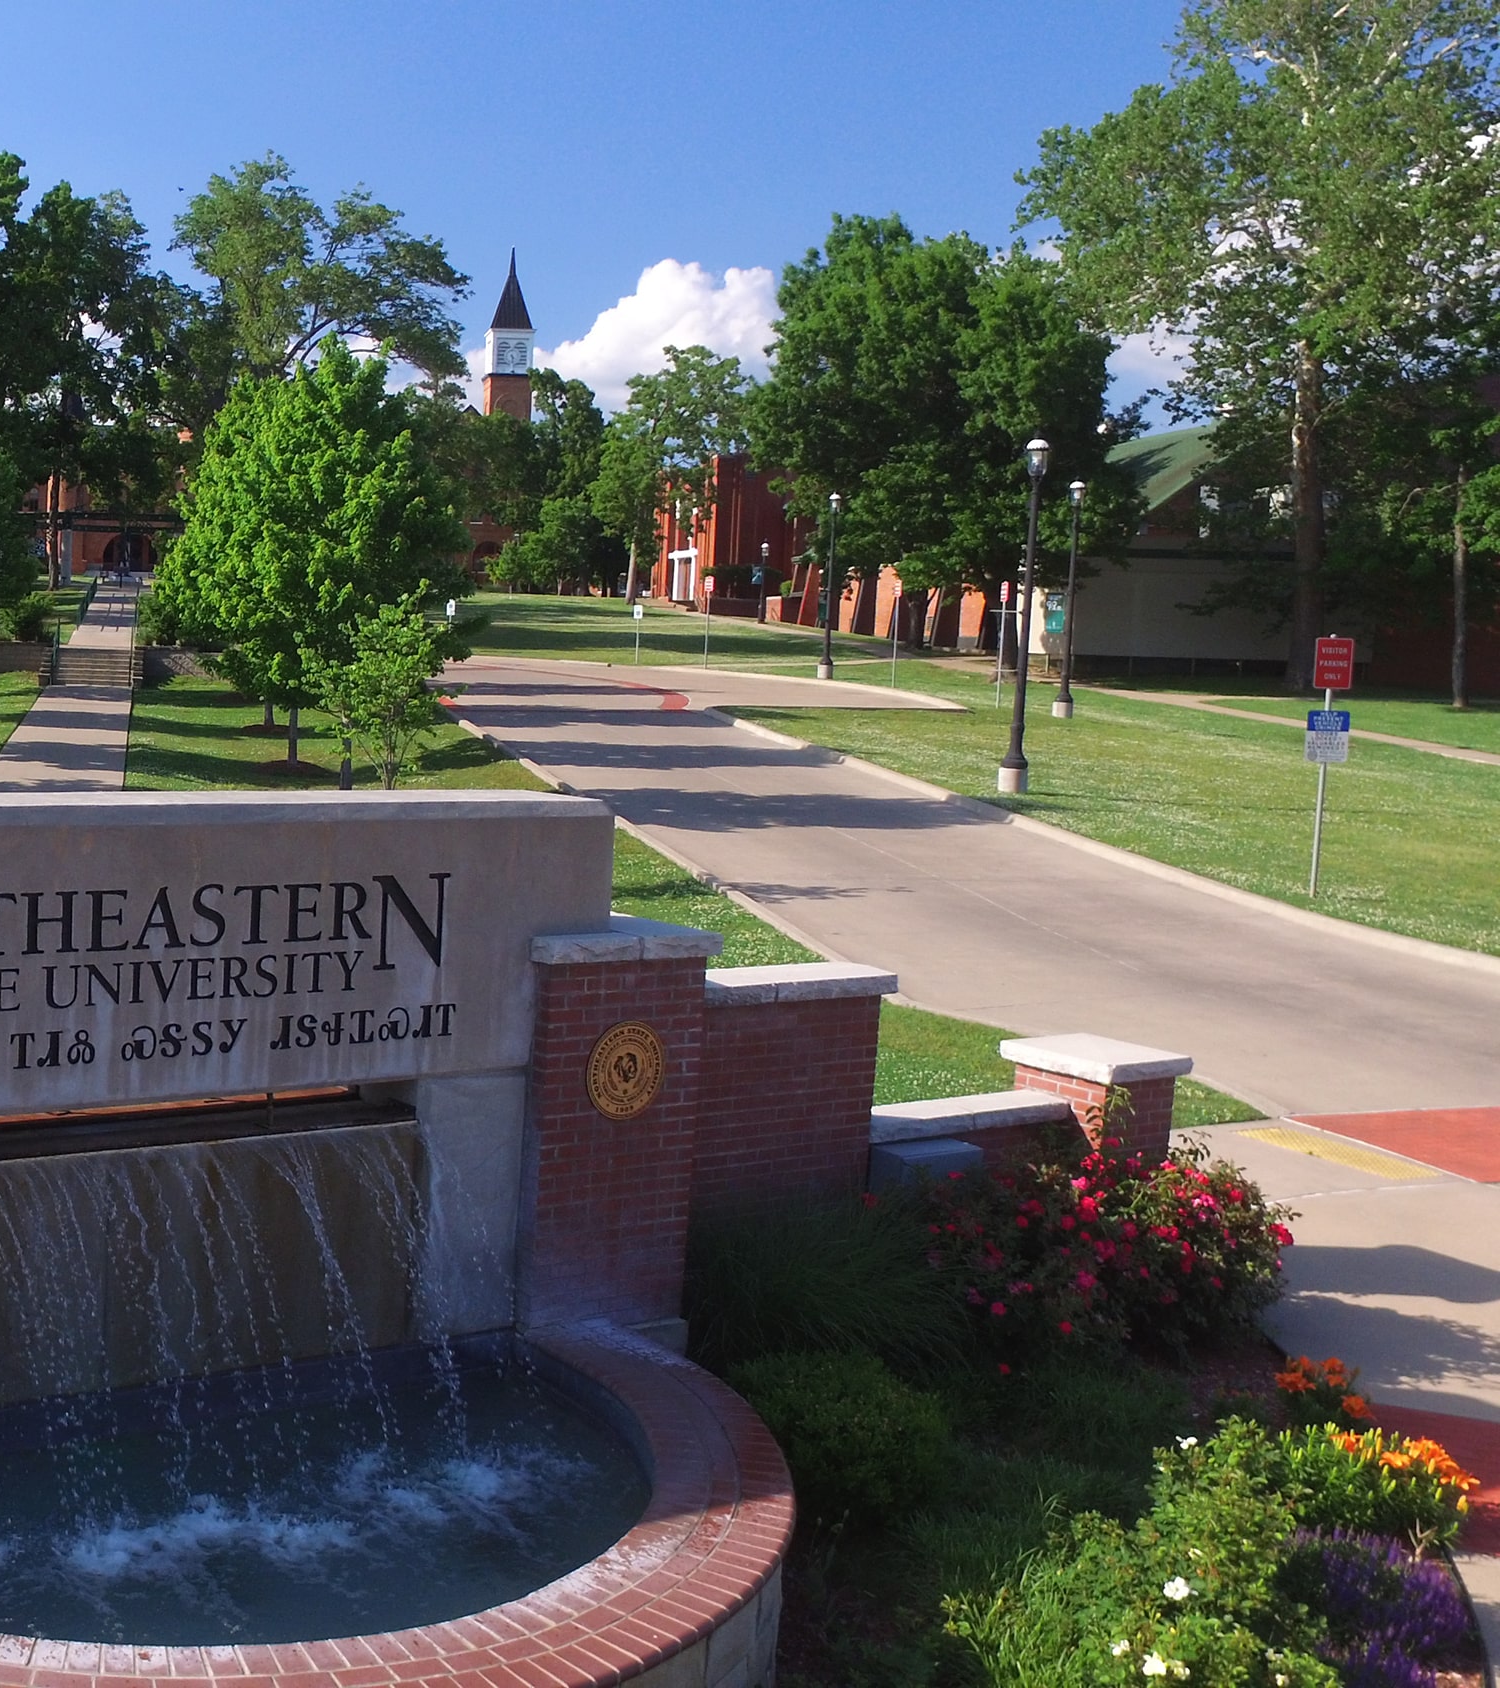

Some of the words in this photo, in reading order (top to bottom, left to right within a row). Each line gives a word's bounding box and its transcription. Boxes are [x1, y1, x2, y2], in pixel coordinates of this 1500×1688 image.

[1321, 647, 1348, 655] VISITOR
[1323, 672, 1341, 680] ONLY
[42, 950, 364, 1010] UNIVERSITY
[592, 1029, 626, 1099] NORTHEASTERN
[626, 1028, 651, 1041] STATE
[649, 1039, 661, 1097] UNIVERSITY
